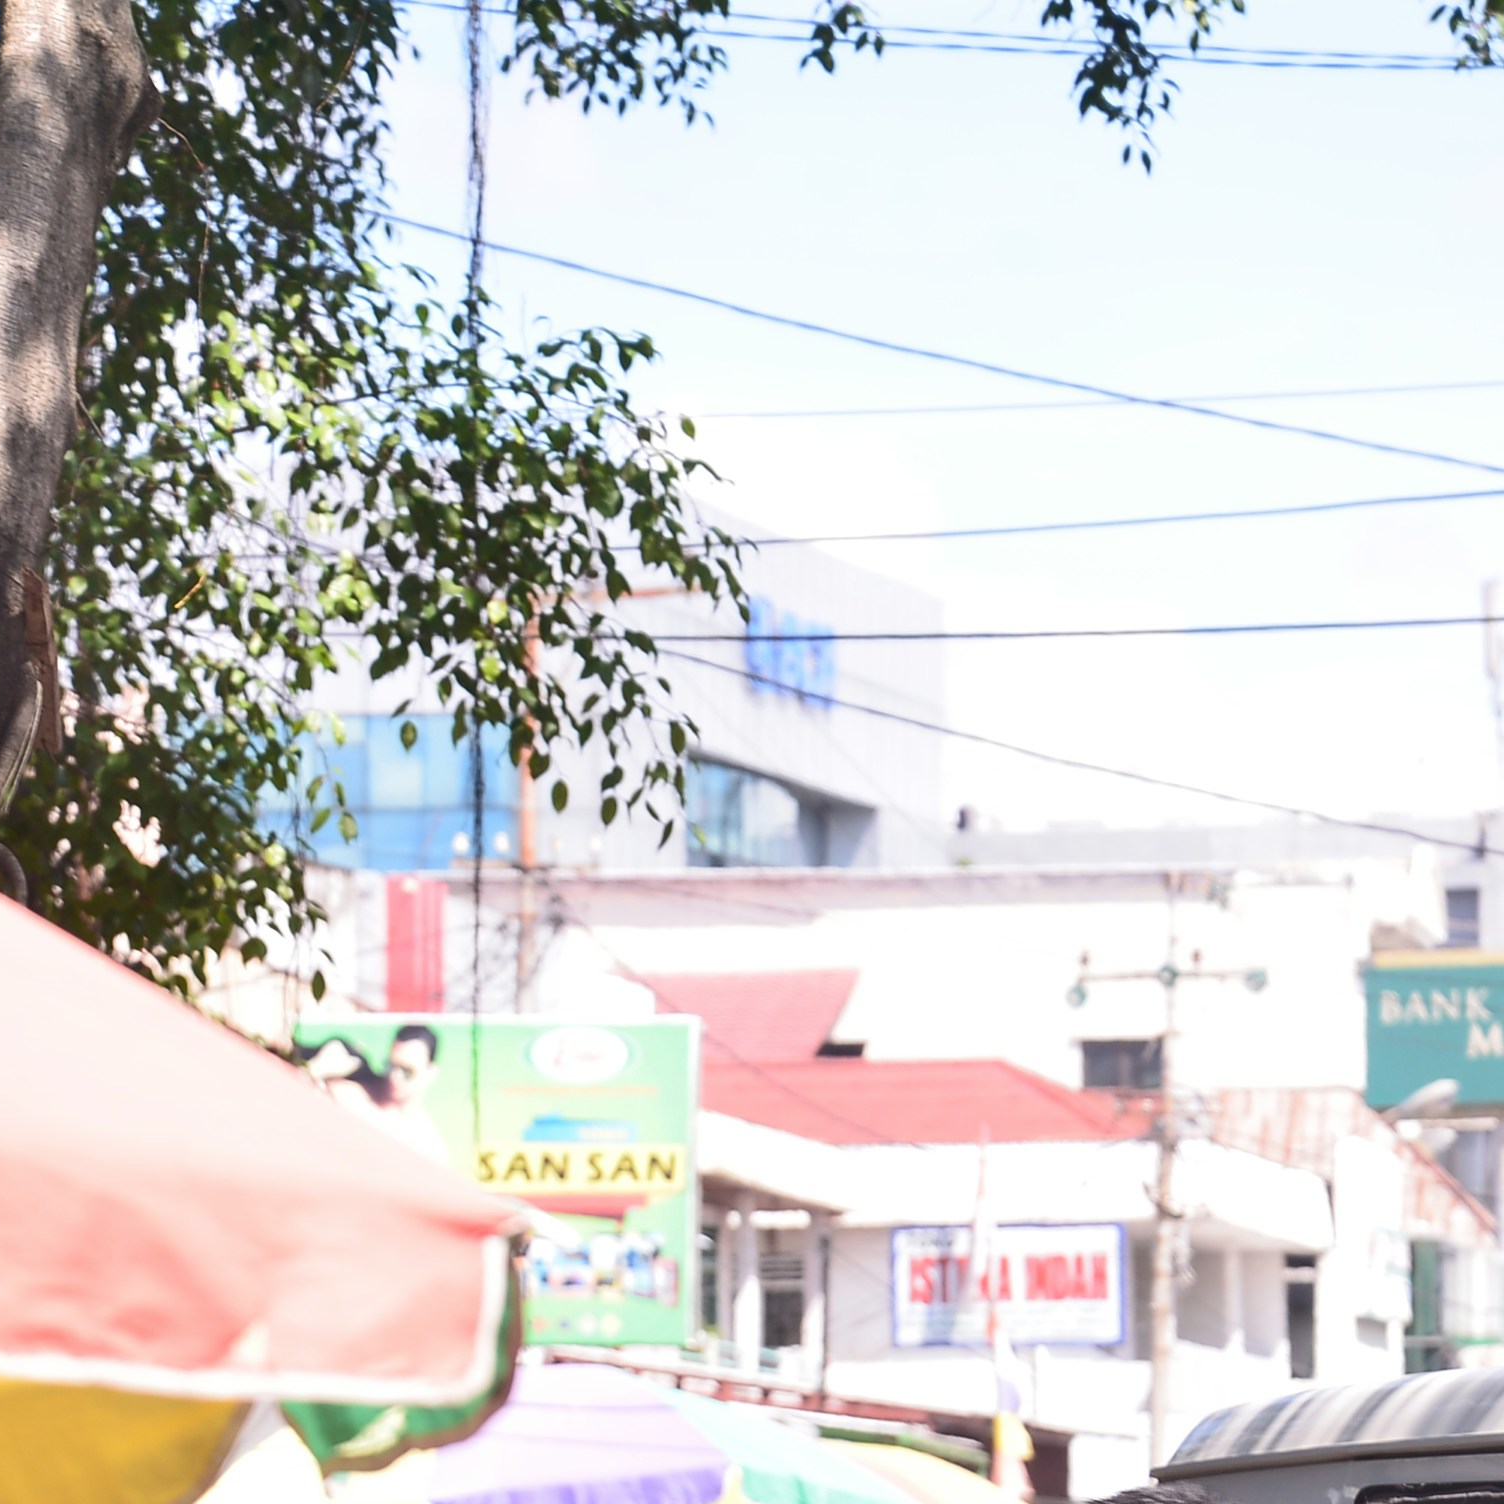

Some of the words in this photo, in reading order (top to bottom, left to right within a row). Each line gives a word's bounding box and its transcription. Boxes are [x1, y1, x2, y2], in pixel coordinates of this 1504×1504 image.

[1379, 987, 1490, 1026] BANK
[477, 1151, 569, 1184] SAN
[586, 1151, 677, 1184] SAN
